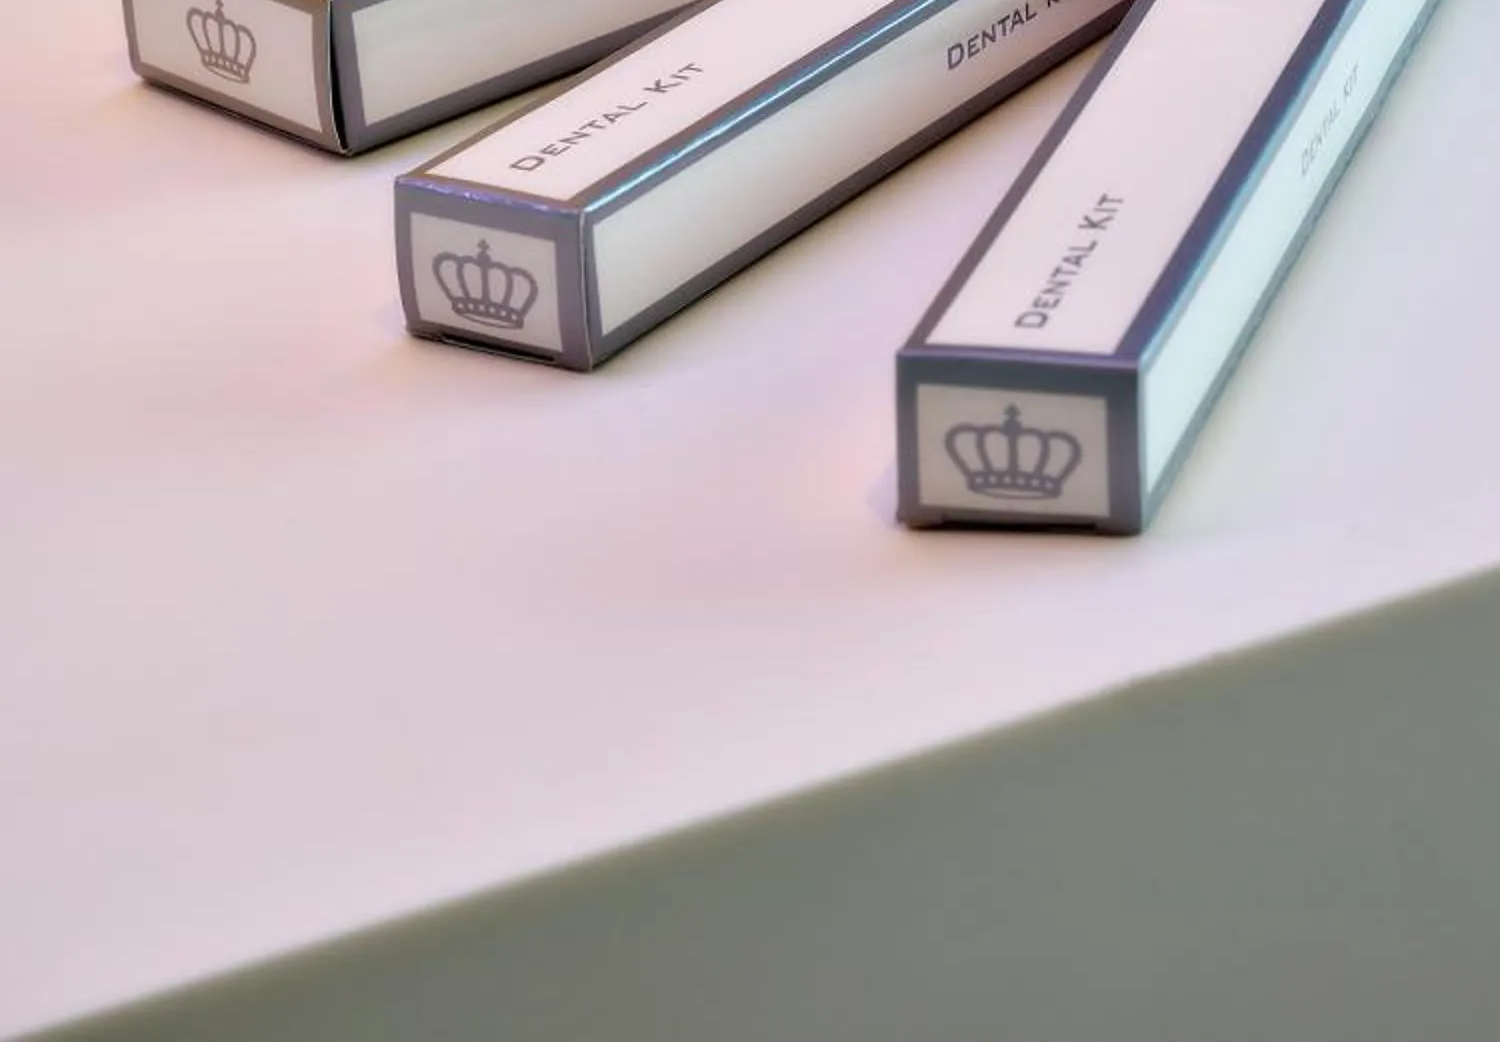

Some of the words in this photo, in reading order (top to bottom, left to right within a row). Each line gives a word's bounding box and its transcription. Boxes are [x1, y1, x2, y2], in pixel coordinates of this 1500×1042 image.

[947, 1, 1037, 70] DENTAL
[509, 100, 648, 172] DENTAL
[643, 62, 704, 94] KIT
[1014, 239, 1098, 329] DENTAL
[1077, 193, 1125, 231] KIT
